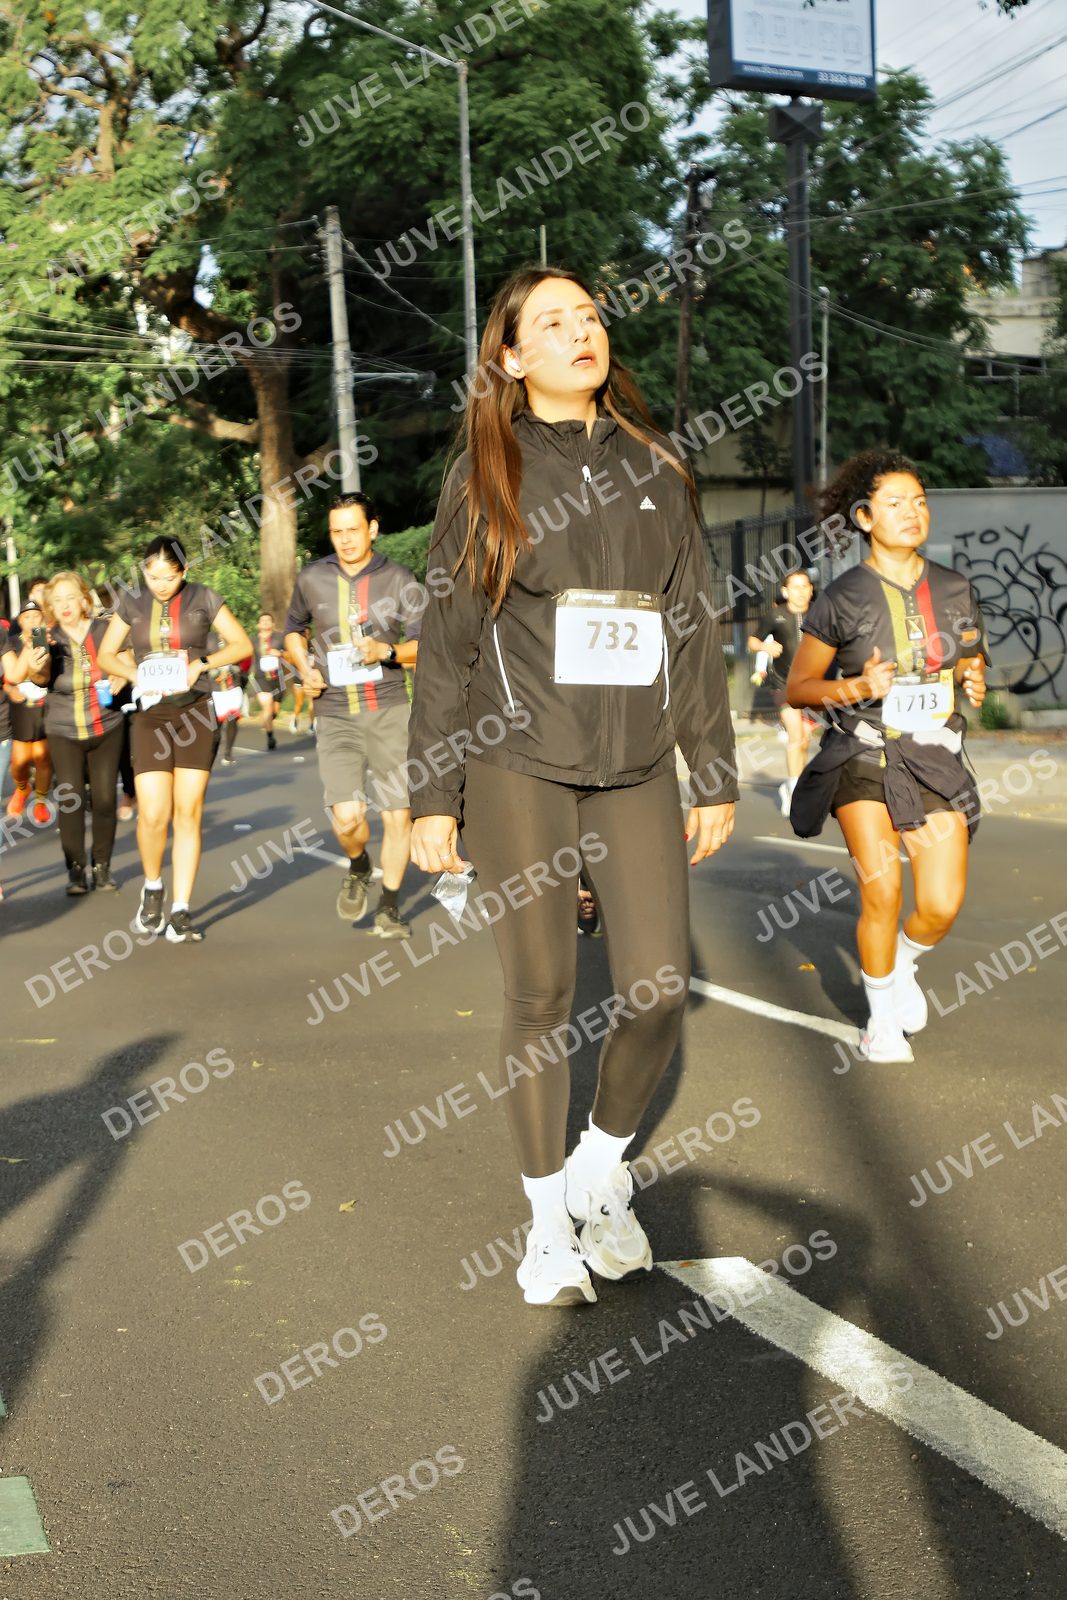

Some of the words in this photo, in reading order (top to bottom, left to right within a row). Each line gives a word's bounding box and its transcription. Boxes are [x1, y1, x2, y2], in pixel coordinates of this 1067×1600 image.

[954, 523, 1030, 553] TOY
[586, 620, 639, 651] 732
[894, 692, 939, 713] 1713
